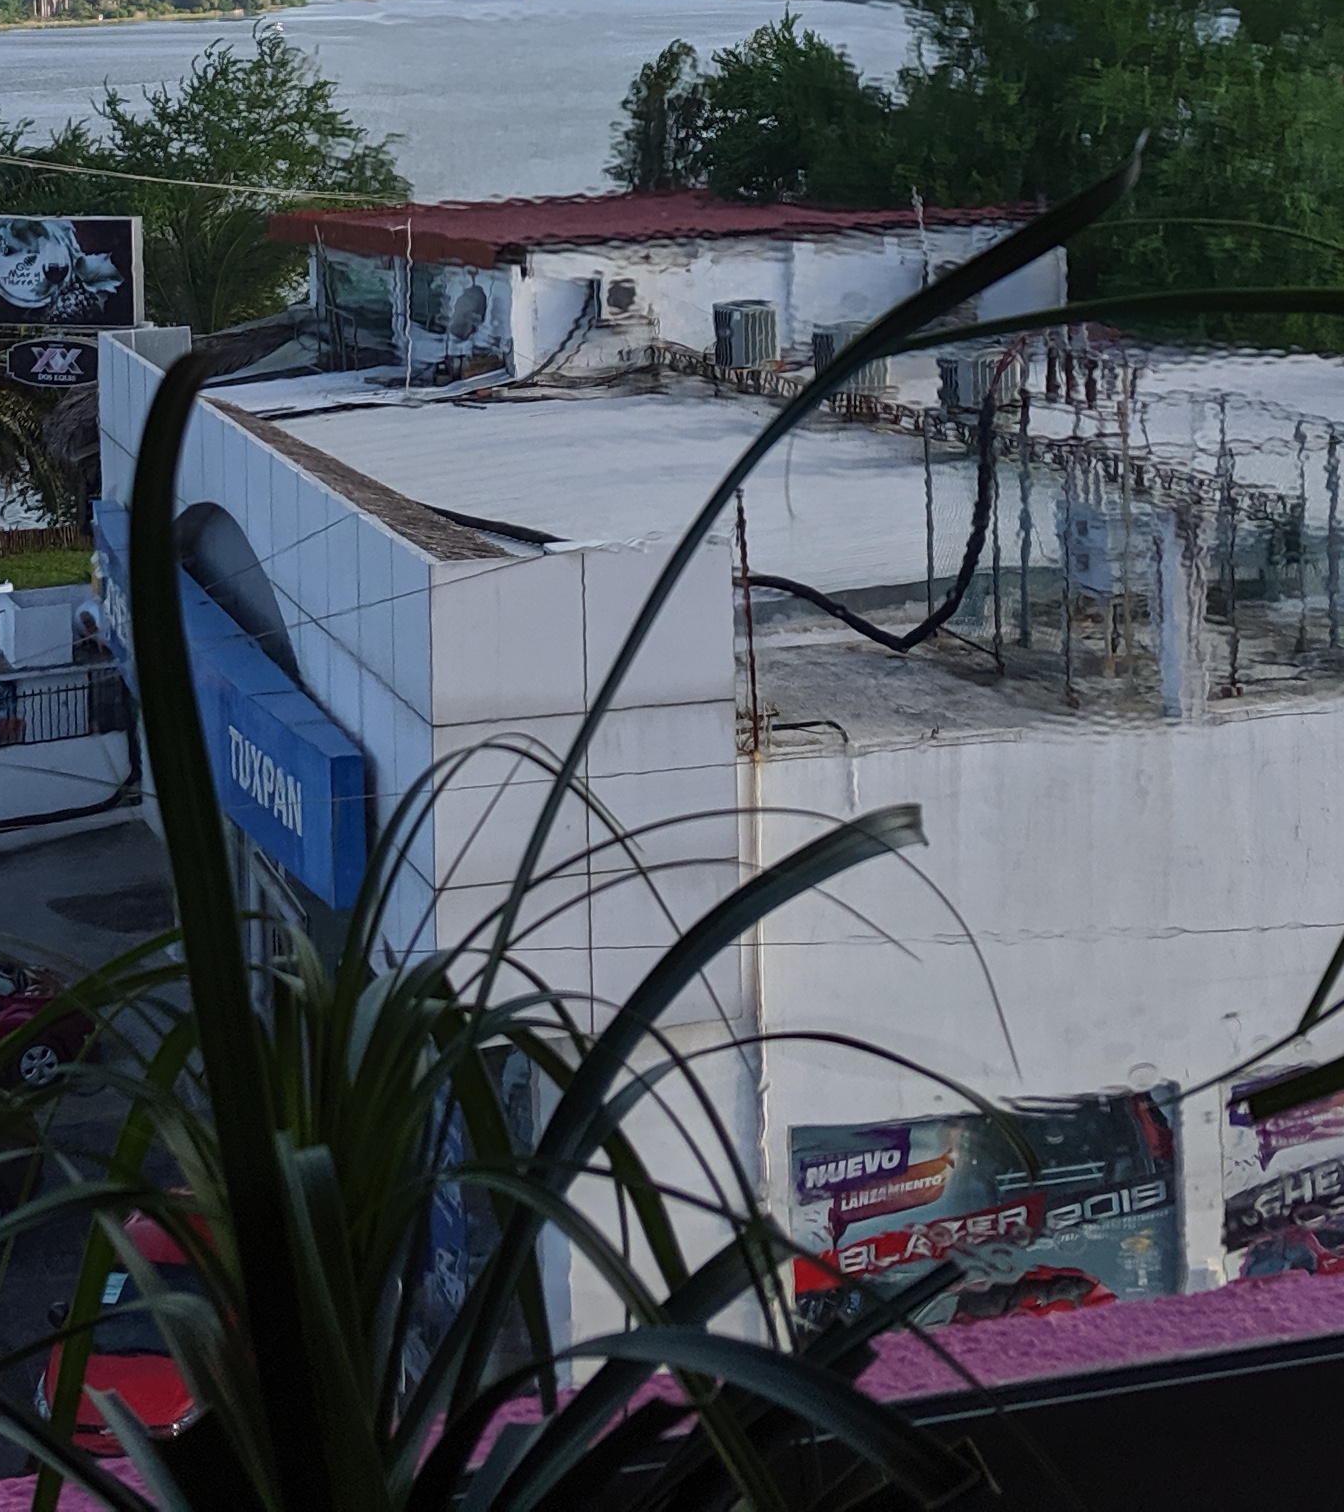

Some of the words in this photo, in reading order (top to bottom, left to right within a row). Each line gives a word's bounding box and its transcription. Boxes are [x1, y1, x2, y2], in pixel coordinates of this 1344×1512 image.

[228, 724, 304, 837] TUXPAN
[805, 1149, 902, 1189] NUEVO
[840, 1175, 944, 1212] LANZAMIENTO
[838, 1205, 1028, 1274] BLAZER
